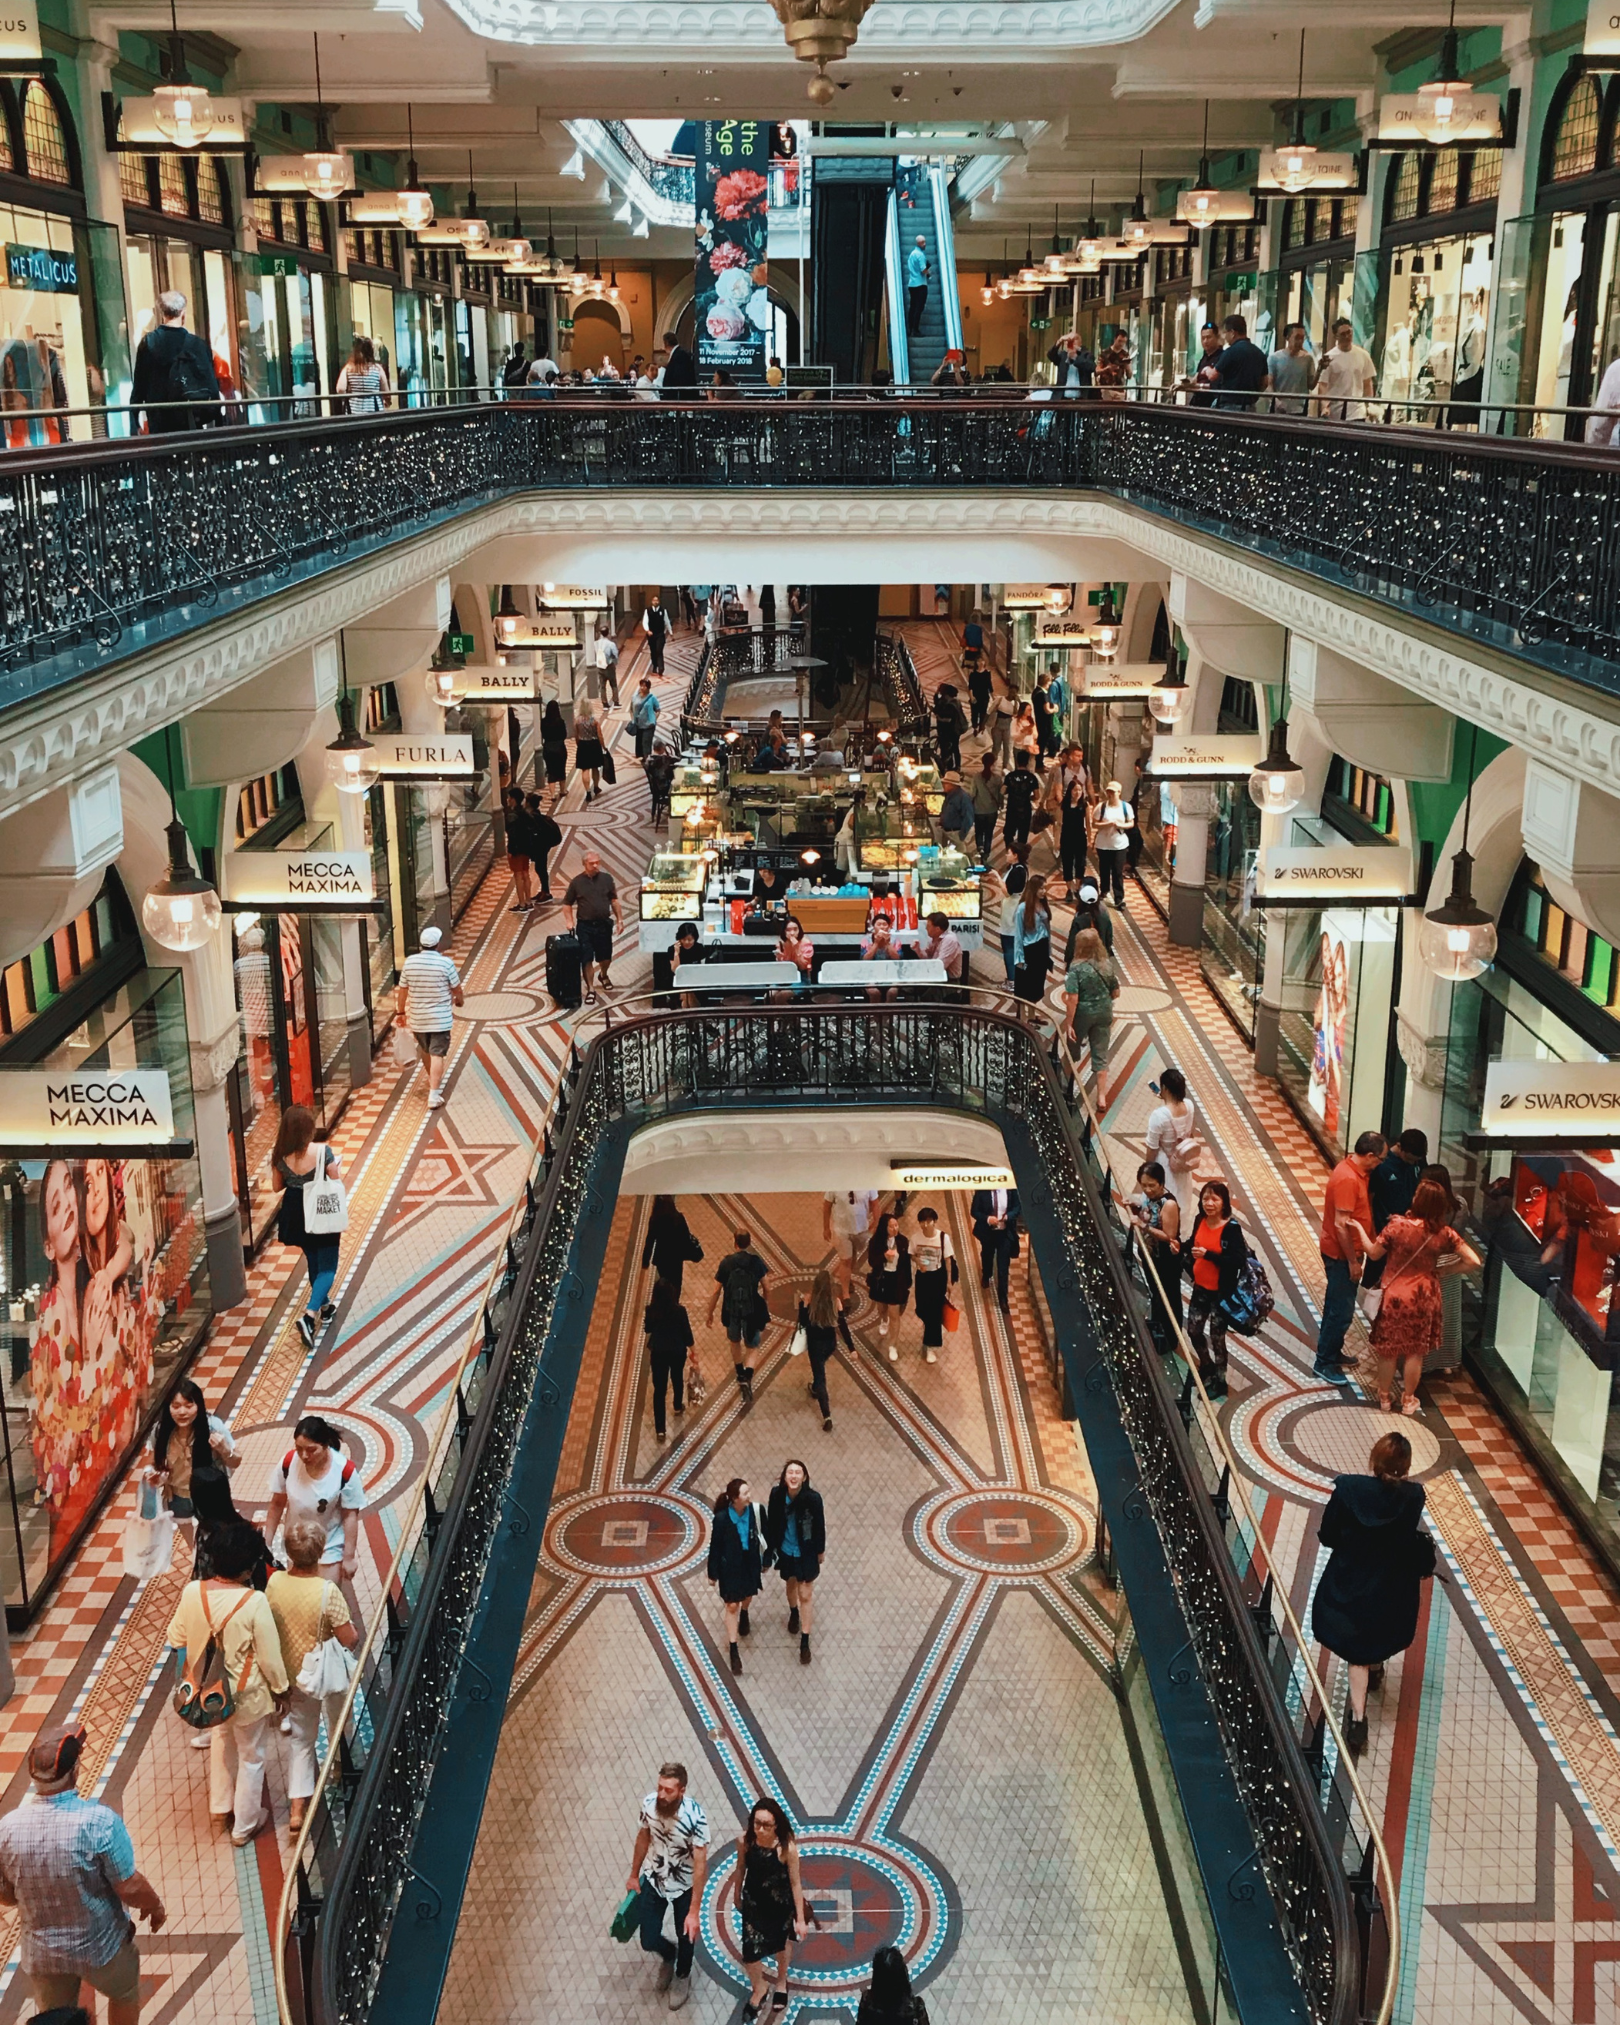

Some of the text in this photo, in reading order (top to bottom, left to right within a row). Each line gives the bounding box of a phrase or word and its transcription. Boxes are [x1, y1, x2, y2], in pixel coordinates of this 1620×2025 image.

[716, 119, 738, 155] Age
[741, 121, 758, 155] the
[10, 256, 77, 284] METALICUS
[706, 347, 739, 356] November
[740, 348, 756, 356] 2017
[707, 357, 736, 366] February
[737, 357, 753, 365] 2018
[532, 627, 572, 636] BALLY
[1042, 623, 1061, 638] Folli
[481, 677, 529, 687] BALLY
[395, 747, 467, 763] FURLA
[288, 863, 355, 878] MECCA
[1291, 867, 1364, 879] SWAROVSKI
[289, 880, 363, 894] MAXIMA
[951, 924, 980, 933] PARISI
[46, 1083, 146, 1104] MECCA
[49, 1107, 158, 1127] MAXIMA
[903, 1174, 1008, 1184] dermalogica
